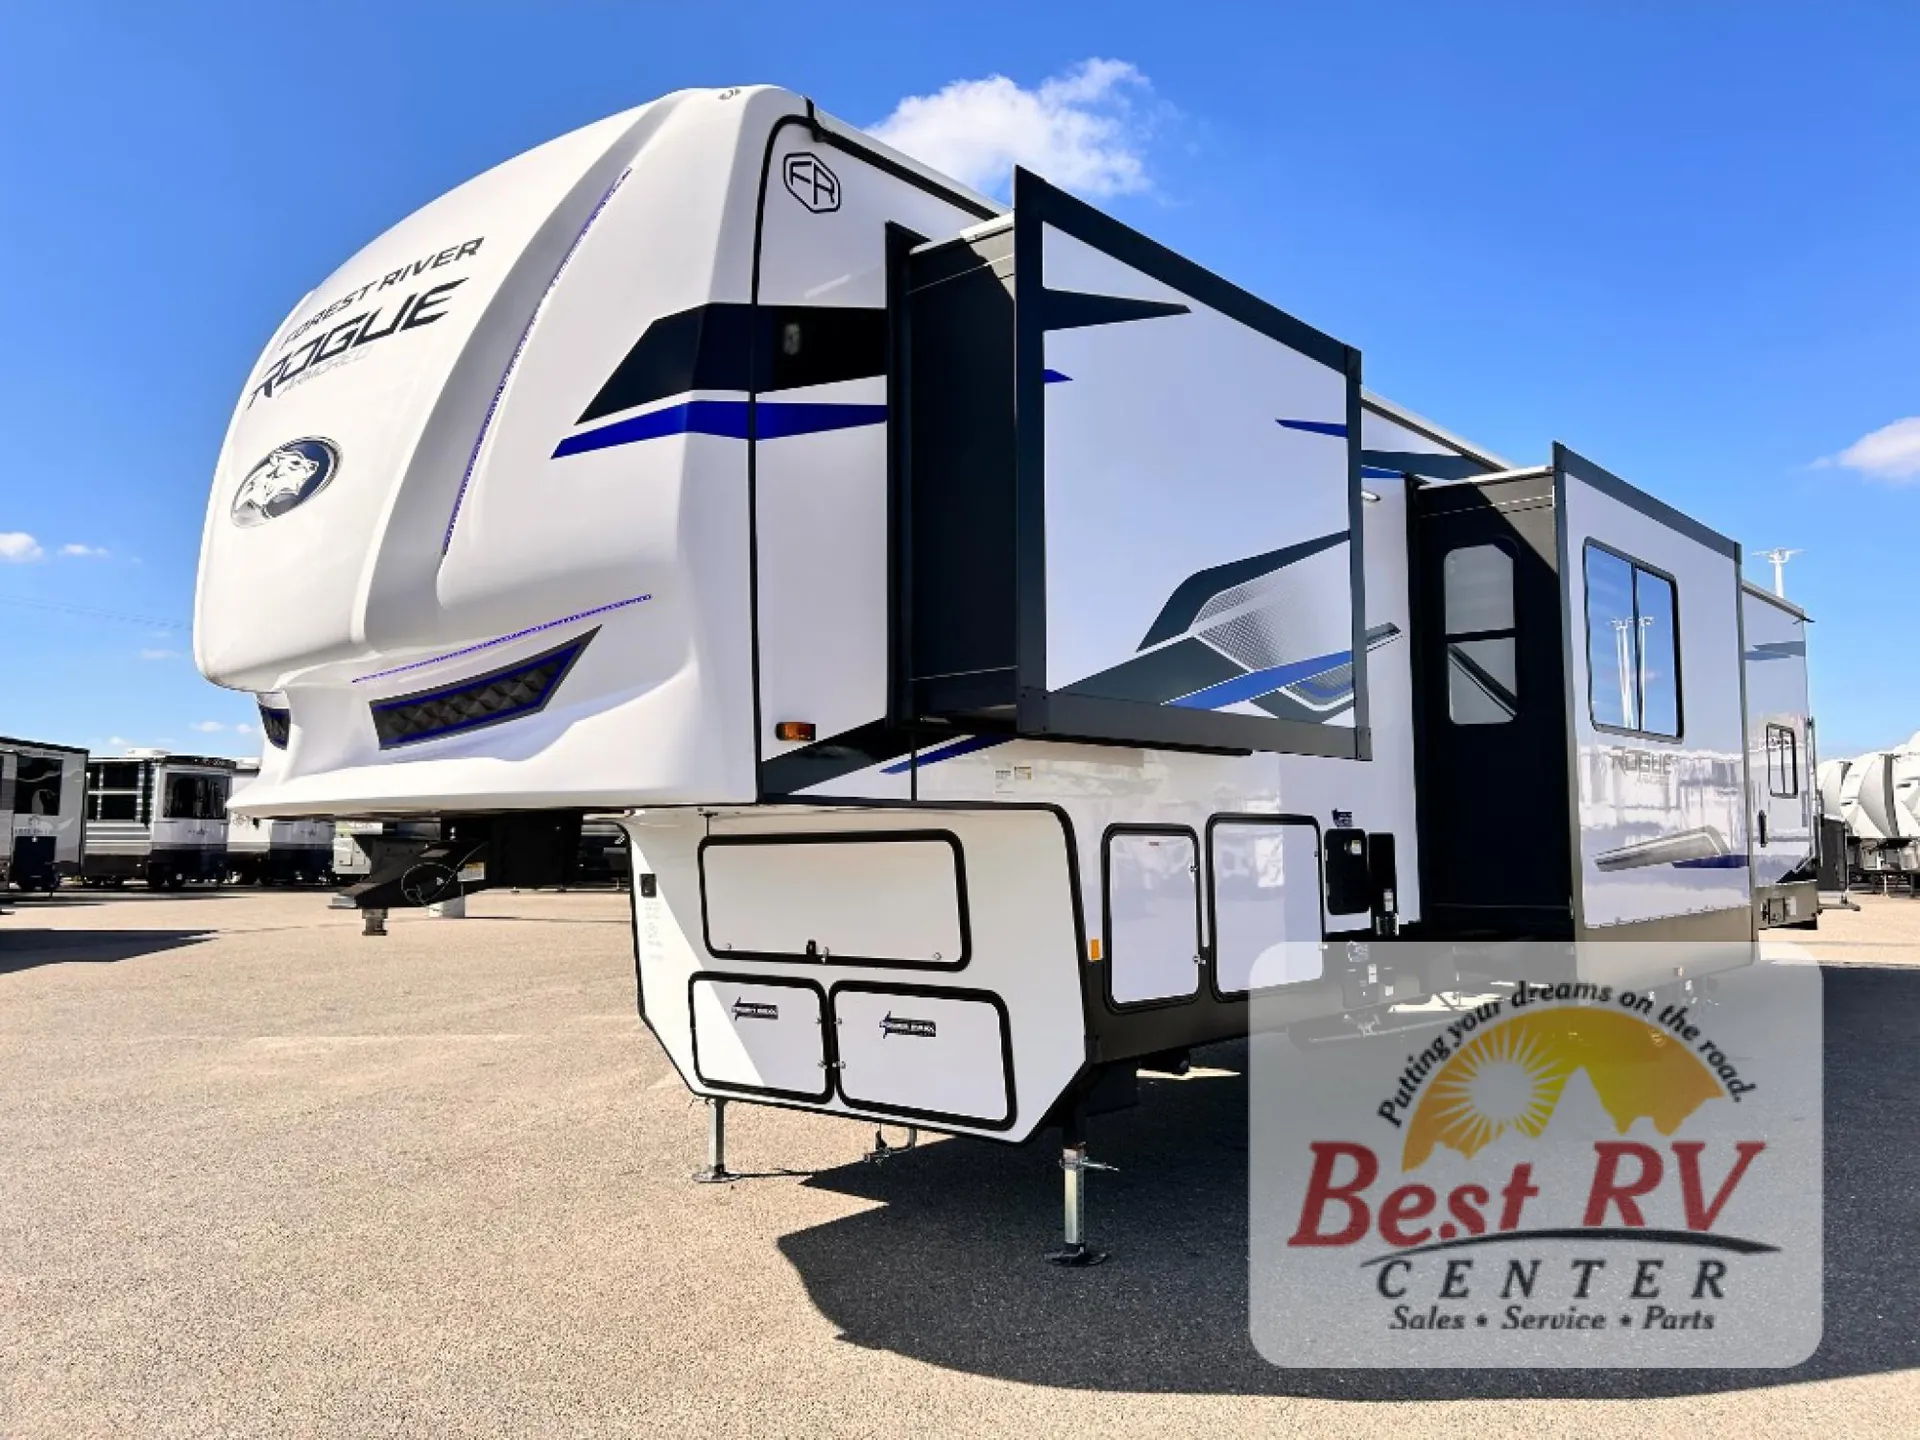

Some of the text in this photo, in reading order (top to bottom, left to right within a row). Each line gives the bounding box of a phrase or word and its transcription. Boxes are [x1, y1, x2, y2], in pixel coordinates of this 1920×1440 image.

[247, 277, 469, 410] ROGUE
[280, 236, 485, 350] FOREST RIVER
